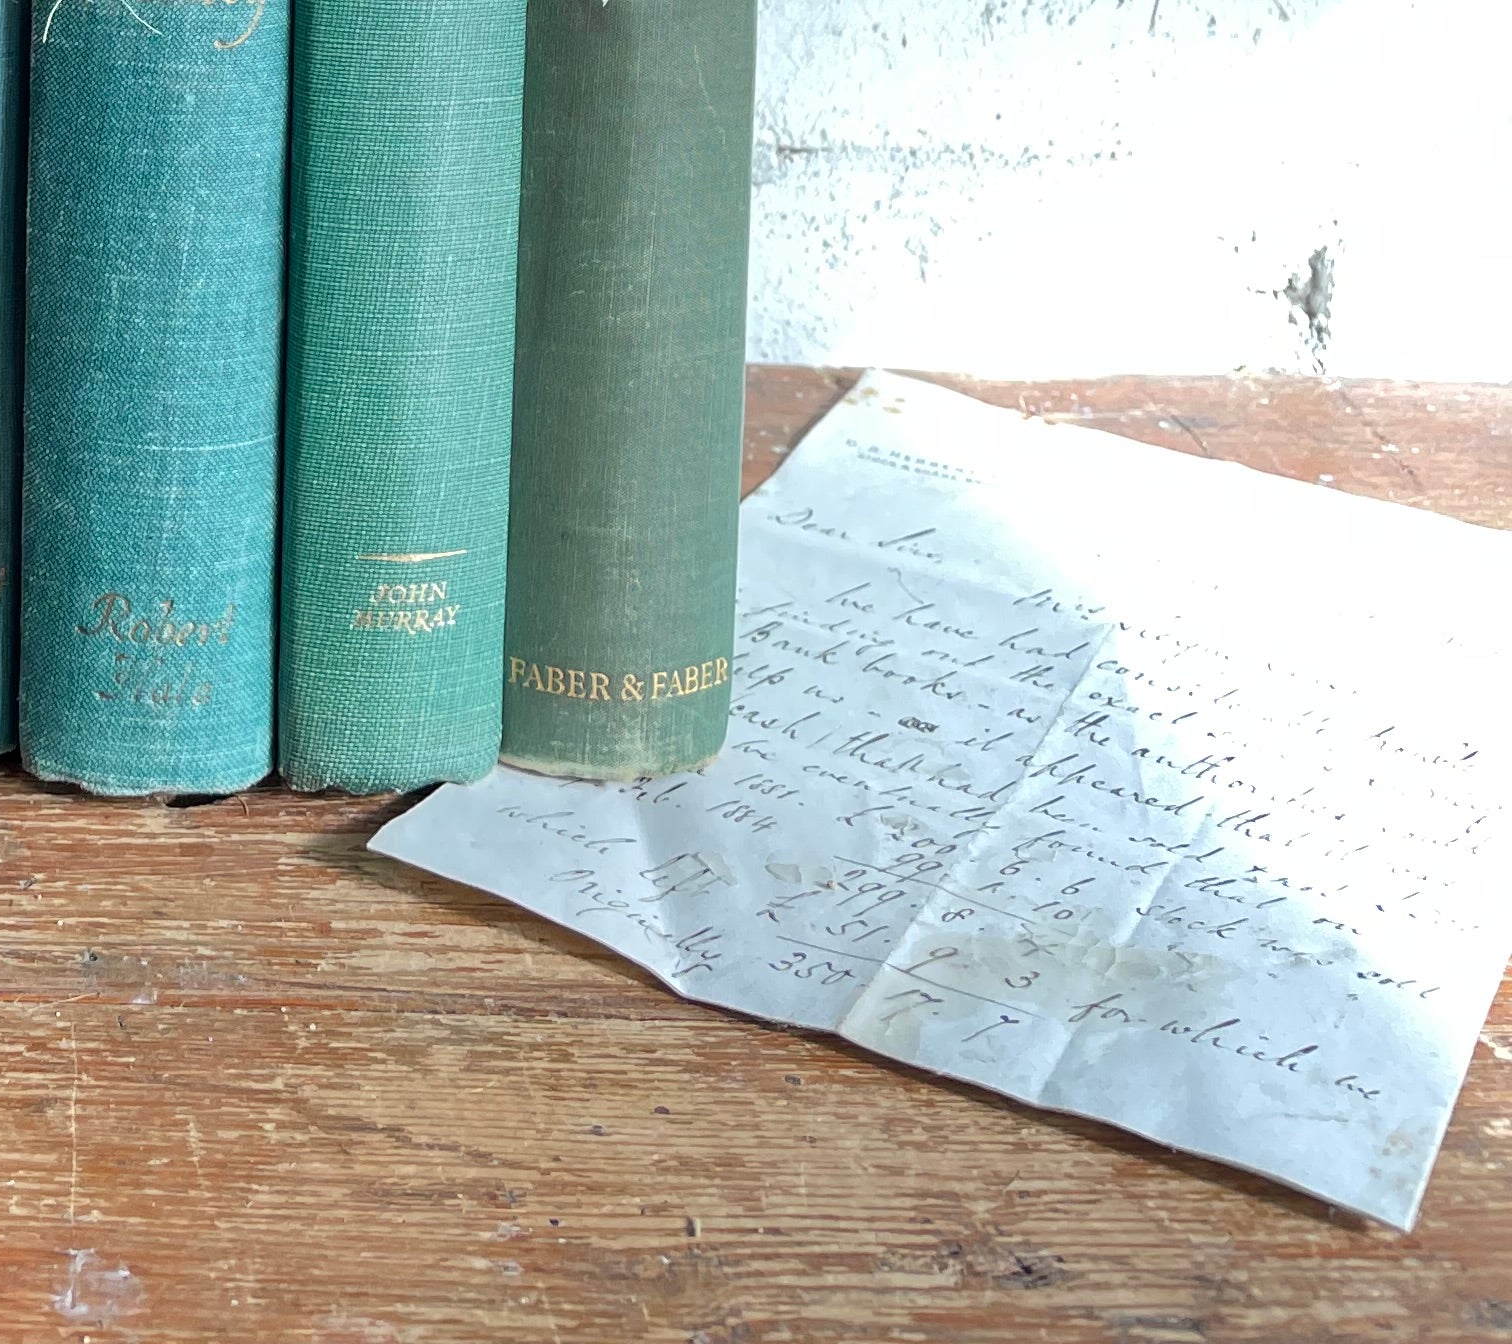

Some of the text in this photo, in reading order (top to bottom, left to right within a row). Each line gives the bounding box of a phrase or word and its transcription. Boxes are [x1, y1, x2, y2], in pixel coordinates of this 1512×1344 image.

[369, 580, 449, 605] JOHN
[74, 591, 237, 647] Robert
[350, 604, 461, 635] MURRAY
[508, 656, 729, 702] FABER & FABER
